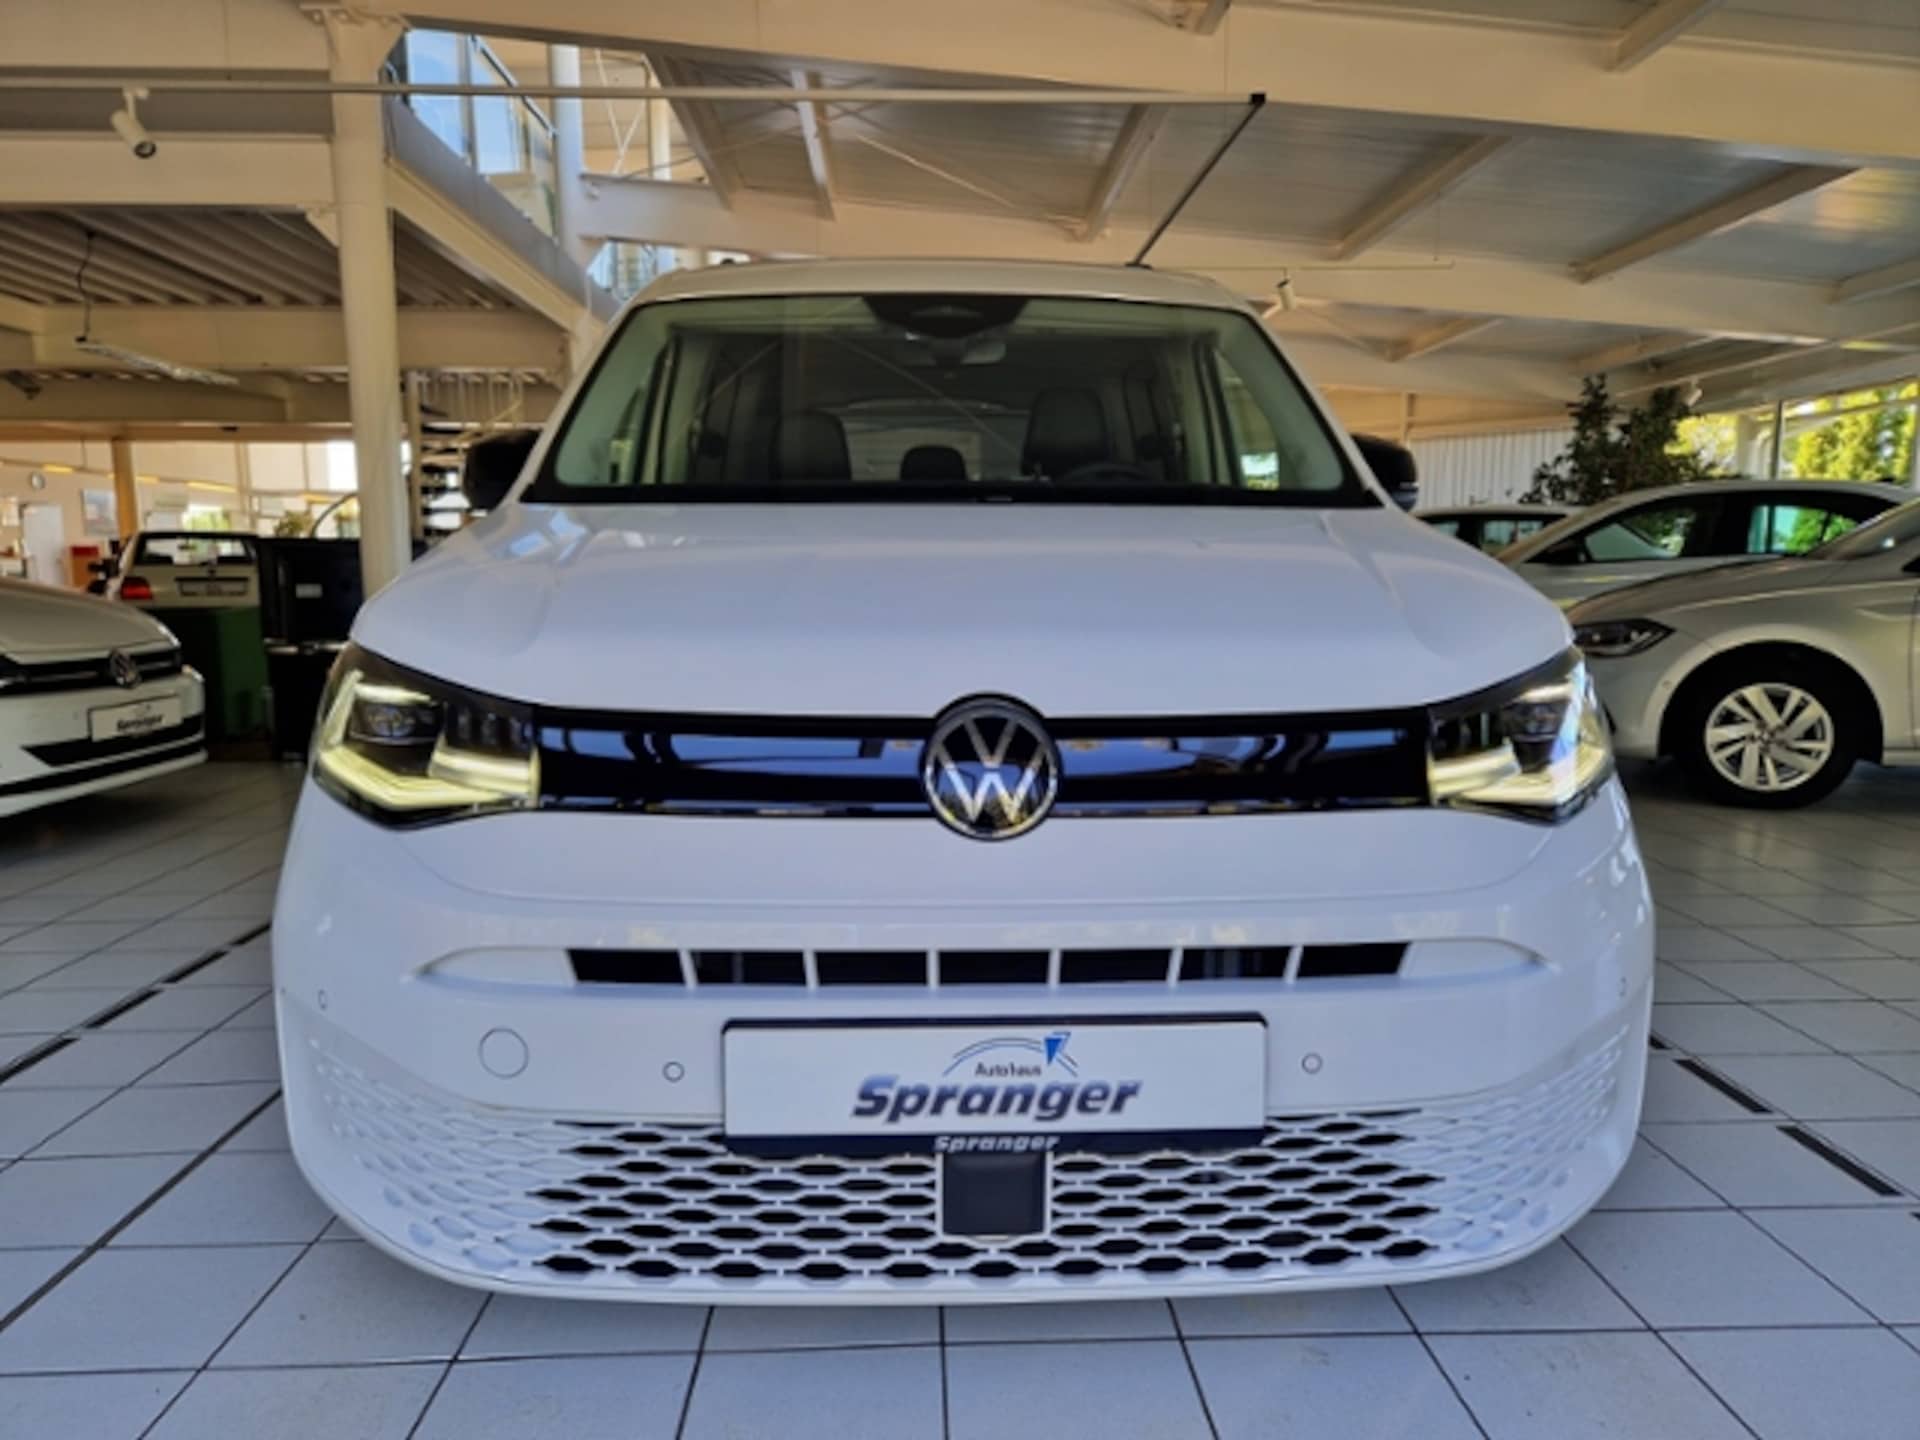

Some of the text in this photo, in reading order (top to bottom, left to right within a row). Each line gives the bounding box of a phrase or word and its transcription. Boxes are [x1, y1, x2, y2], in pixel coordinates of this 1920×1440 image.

[929, 711, 1054, 828] VW
[852, 1074, 1142, 1123] Spranger
[933, 1135, 1061, 1152] Spranger
